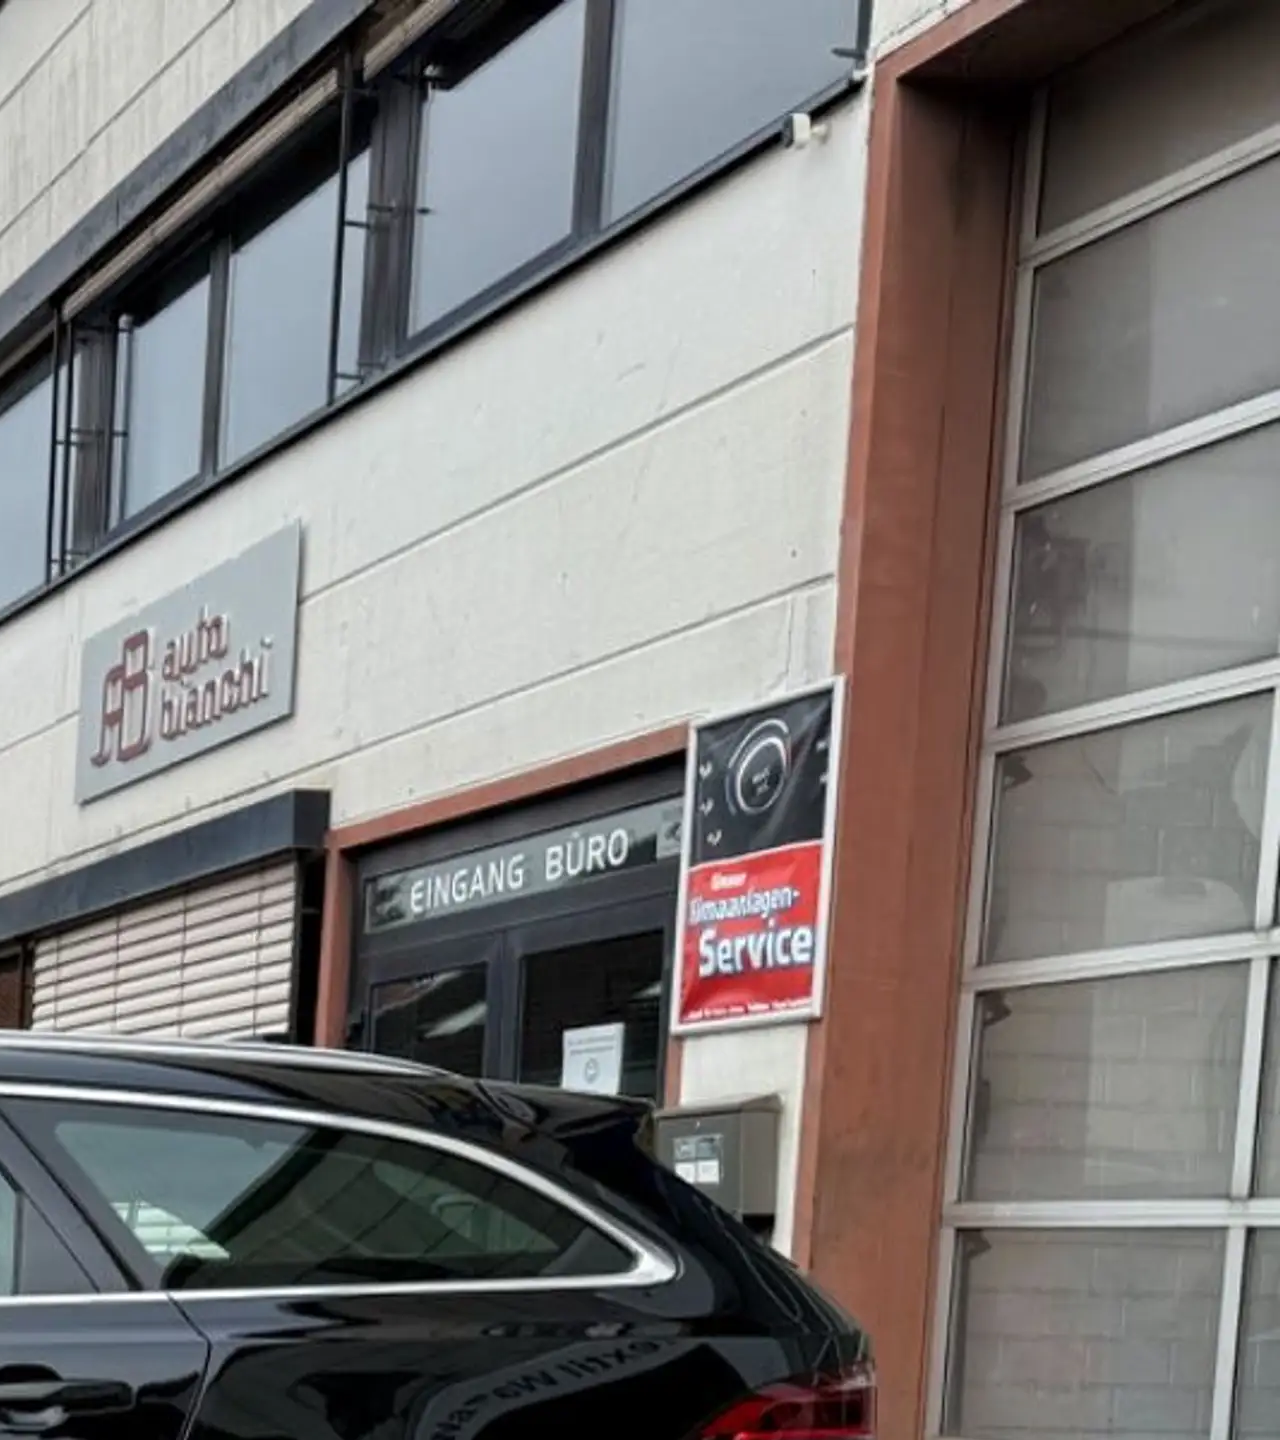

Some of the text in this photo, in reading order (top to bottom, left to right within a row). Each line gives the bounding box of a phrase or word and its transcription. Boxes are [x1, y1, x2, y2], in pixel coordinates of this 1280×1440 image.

[163, 604, 229, 682] auto
[160, 636, 273, 741] bianchi
[410, 828, 629, 914] EINGANG BÜRO
[698, 917, 814, 978] Service
